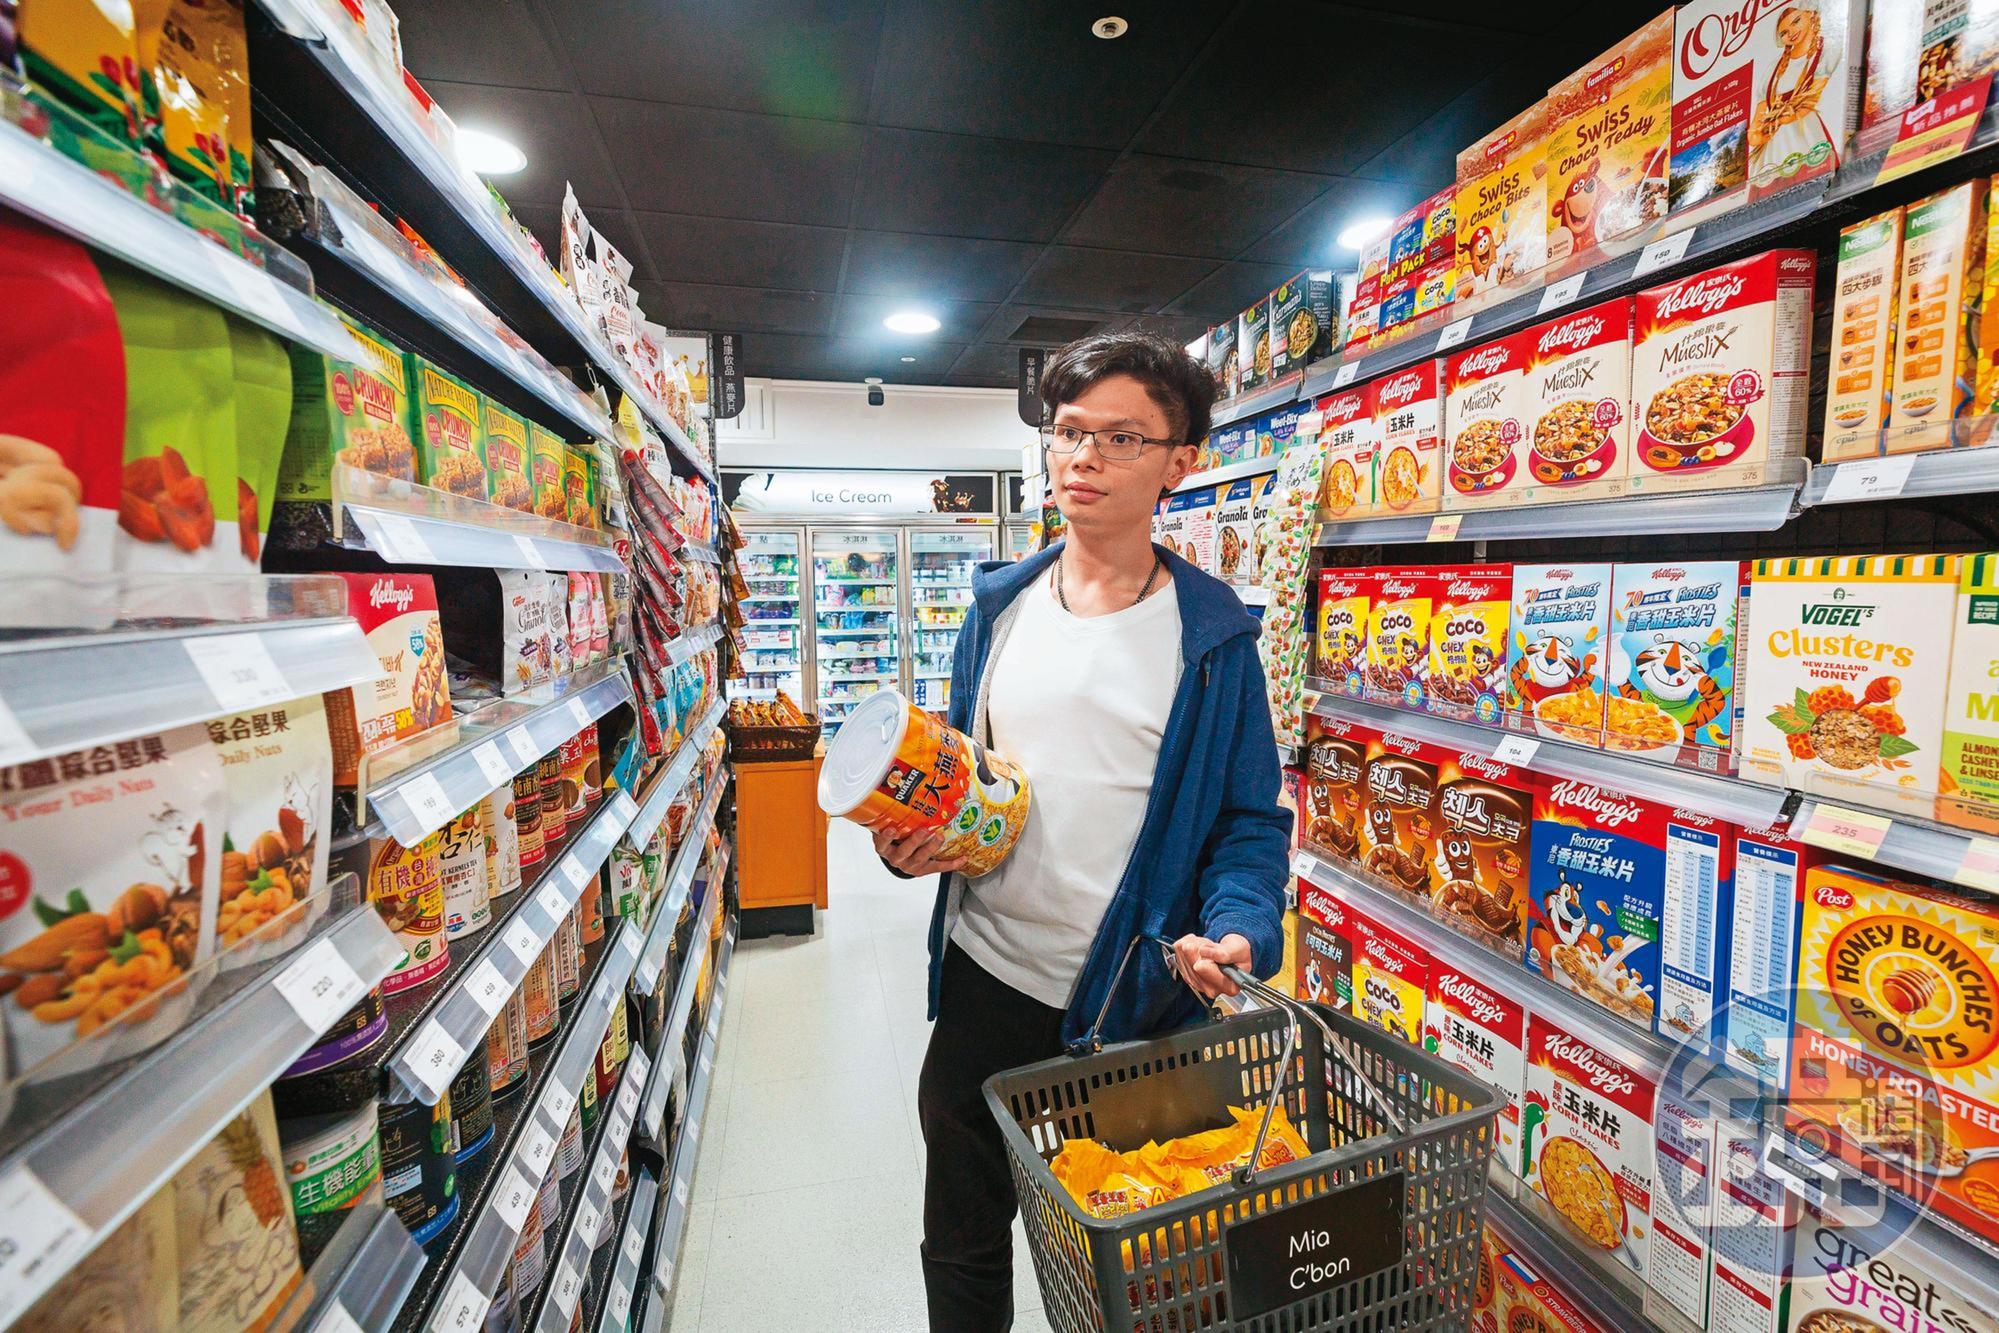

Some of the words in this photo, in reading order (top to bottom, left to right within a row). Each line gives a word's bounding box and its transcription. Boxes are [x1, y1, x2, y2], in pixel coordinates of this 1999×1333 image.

[1587, 66, 1614, 88] familia
[1576, 104, 1630, 148] Swiss
[1723, 109, 1744, 123] Flakes
[1487, 137, 1508, 156] familia
[1558, 145, 1600, 176] Choco
[1603, 113, 1656, 150] Teddy
[1479, 172, 1520, 208] Swiss
[1469, 201, 1502, 227] Choco
[1504, 184, 1531, 208] Bits
[1401, 252, 1426, 277] PACK
[1780, 256, 1812, 272] Kellogg's
[1424, 281, 1444, 296] COCO
[1655, 276, 1747, 319] Kellogg's
[1537, 317, 1605, 352] Kellogg's
[1659, 324, 1740, 372] MuesliX
[1458, 346, 1510, 377] Kellogg's
[352, 367, 396, 414] CRUNCHY
[1379, 376, 1422, 404] Kellogg's
[1542, 361, 1602, 399] MuesliX
[1734, 386, 1753, 397] 60%
[1325, 397, 1362, 421] Kellogg's
[1460, 386, 1506, 418] MuesliX
[440, 408, 472, 441] CRUNCHY
[1270, 413, 1298, 430] Weet-Bix
[1389, 412, 1415, 433] 玉米片
[1332, 429, 1355, 447] 玉米片
[1742, 472, 1758, 481] 375
[1860, 475, 1877, 486] 79
[811, 489, 834, 503] Ice
[838, 488, 892, 504] Cream
[1608, 485, 1621, 494] 375
[1160, 517, 1183, 532] Granola
[1217, 506, 1249, 523] Granola
[1545, 569, 1574, 581] Kellogg's
[1651, 568, 1687, 580] Kellogg's
[369, 578, 414, 613] Kellogg's
[1328, 581, 1359, 598] Kellogg's
[1382, 581, 1417, 598] Kellogg's
[1447, 580, 1491, 601] Kellogg's
[1523, 588, 1540, 605] 70
[1565, 582, 1600, 600] FROSTIES
[1625, 590, 1645, 609] 70
[1675, 582, 1722, 603] FROSTIES
[1327, 611, 1353, 627] COCO
[1381, 614, 1413, 631] COCO
[1531, 601, 1596, 624] 香甜玉米片
[1636, 604, 1717, 631] 香甜玉米片
[1801, 603, 1877, 627] VOGEL'S
[1972, 610, 1997, 621] RECIPE
[1323, 630, 1340, 641] CHEX
[1445, 618, 1486, 637] COCO
[411, 637, 424, 652] 58%
[1377, 634, 1396, 646] CHEX
[1440, 641, 1465, 654] CHEX
[1768, 627, 1915, 668] Clusters
[1802, 660, 1823, 671] NEW
[1824, 661, 1869, 673] ZEALAND
[1810, 668, 1858, 682] HONEY
[206, 710, 292, 747] 綜合堅果
[1320, 717, 1353, 735] Kellogg's
[1382, 731, 1422, 754] Kellogg's
[218, 750, 250, 768] Daily
[253, 743, 283, 760] Nuts
[1310, 743, 1341, 779] 첵스
[1458, 752, 1511, 779] Kellogg's
[1340, 768, 1360, 785] 초코
[1368, 761, 1407, 803] 첵스
[1959, 765, 1968, 777] &
[70, 786, 114, 809] Daily
[118, 778, 156, 796] Nuts
[895, 769, 920, 801] QUAKER
[911, 799, 938, 818] 桂格
[1407, 791, 1431, 811] 초코
[1442, 786, 1491, 837] 첵스
[1550, 780, 1643, 828] Kellogg's
[1673, 807, 1714, 827] Kellogg's
[438, 820, 482, 861] 杏仁
[1490, 823, 1521, 844] 초코
[1569, 832, 1614, 855] FROSTIES
[1744, 824, 1792, 844] Kellogg's
[1831, 825, 1857, 838] 235
[1556, 846, 1636, 884] 香甜玉米片
[377, 865, 412, 895] 有機
[1305, 890, 1346, 927] Kellogg's
[1815, 886, 1850, 909] Post
[1365, 938, 1407, 973] Kellogg's
[1835, 923, 1895, 985] HONEY
[312, 974, 334, 999] 220
[1900, 924, 1993, 1035] BUNCHES
[1364, 977, 1402, 1012] COCO
[1439, 973, 1508, 1024] Kellogg's
[1361, 997, 1383, 1020] CHEX
[1443, 1032, 1465, 1055] CORN
[1465, 1045, 1495, 1071] FLAKES
[1451, 1019, 1495, 1060] 玉米片
[1875, 1020, 1970, 1063] OATS
[430, 1048, 445, 1069] 380
[1544, 1032, 1638, 1095] Kellogg's
[1810, 1035, 1884, 1079] HONEY
[1563, 1086, 1623, 1139] 玉米片
[1663, 1102, 1704, 1130] Kellogg's
[1552, 1100, 1580, 1127] CORN
[1581, 1117, 1621, 1151] FLAKES
[511, 1190, 523, 1210] 439
[1288, 1228, 1331, 1258] Mia
[1288, 1255, 1351, 1292] C'bon
[1812, 1226, 1943, 1323] great
[456, 1304, 471, 1330] 570
